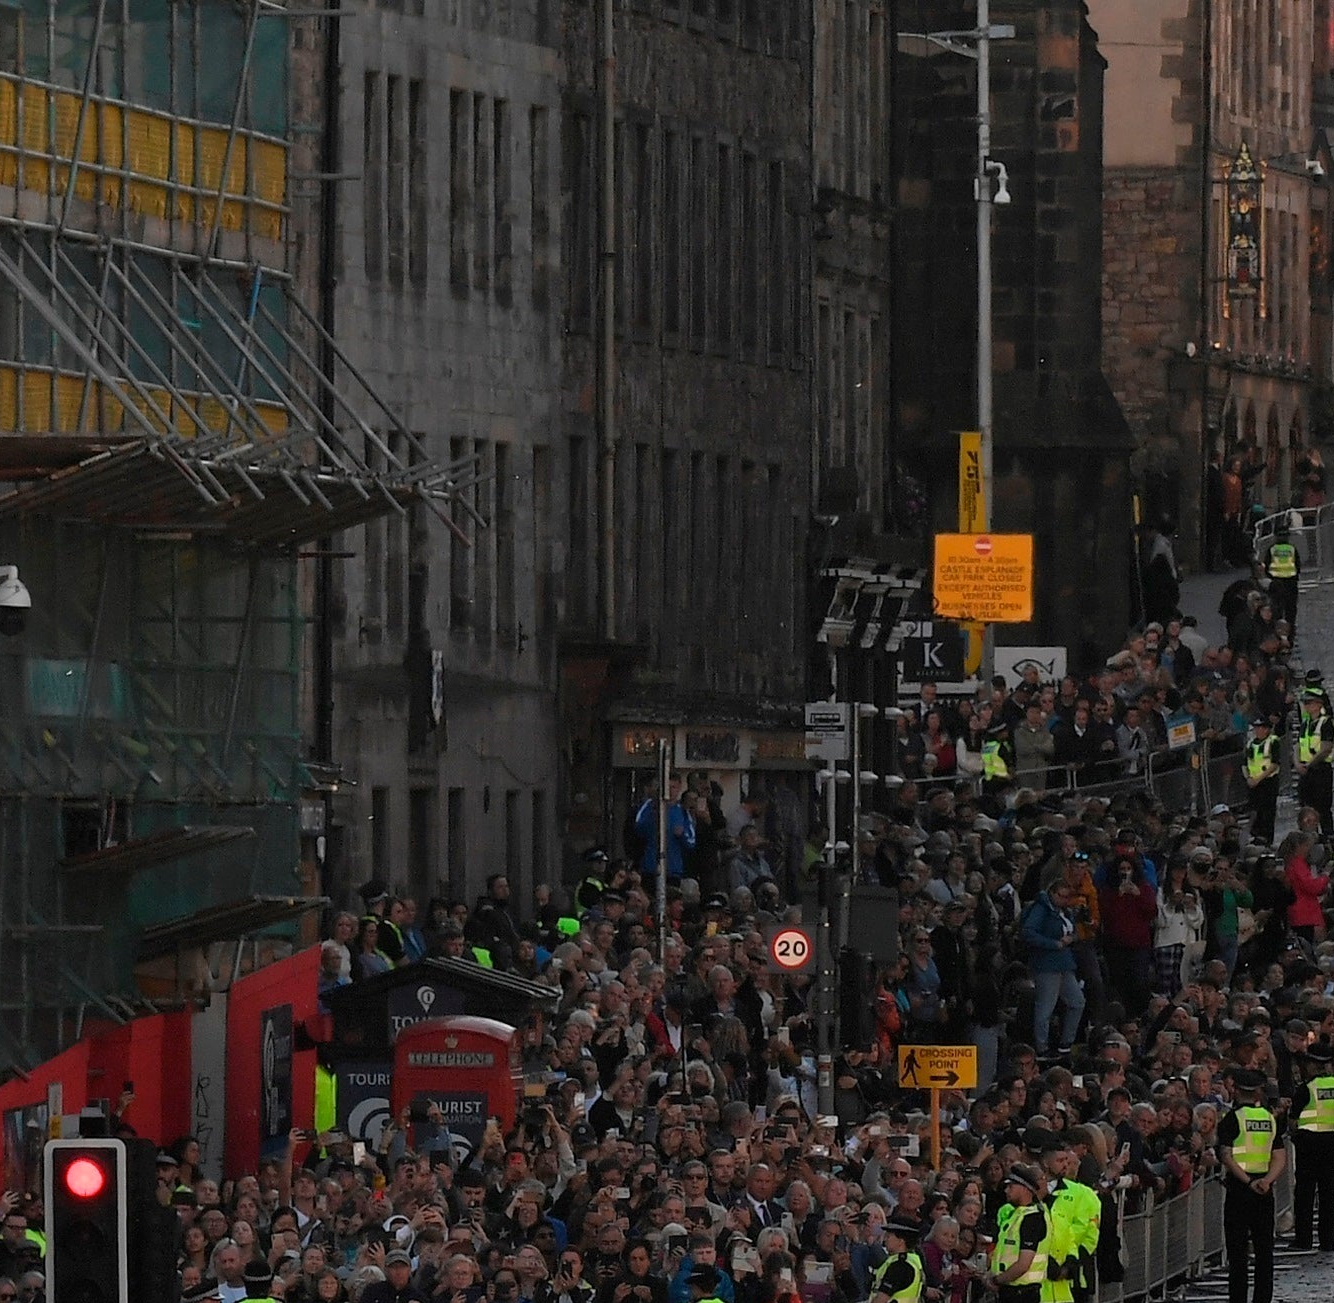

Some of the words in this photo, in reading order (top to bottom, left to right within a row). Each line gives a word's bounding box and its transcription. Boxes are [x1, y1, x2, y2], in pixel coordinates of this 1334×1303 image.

[942, 574, 960, 582] CAR
[987, 574, 1022, 582] CLOSED
[938, 584, 970, 592] EXCEPT
[962, 592, 1003, 600] VEHICLES
[999, 602, 1022, 611] OPEN
[923, 643, 943, 667] K
[778, 940, 805, 957] 20
[920, 1049, 972, 1058] CROSSING
[929, 1060, 959, 1069] POINT
[347, 1073, 390, 1085] TOURI
[439, 1101, 482, 1114] URIST
[1247, 1120, 1272, 1132] POLICE
